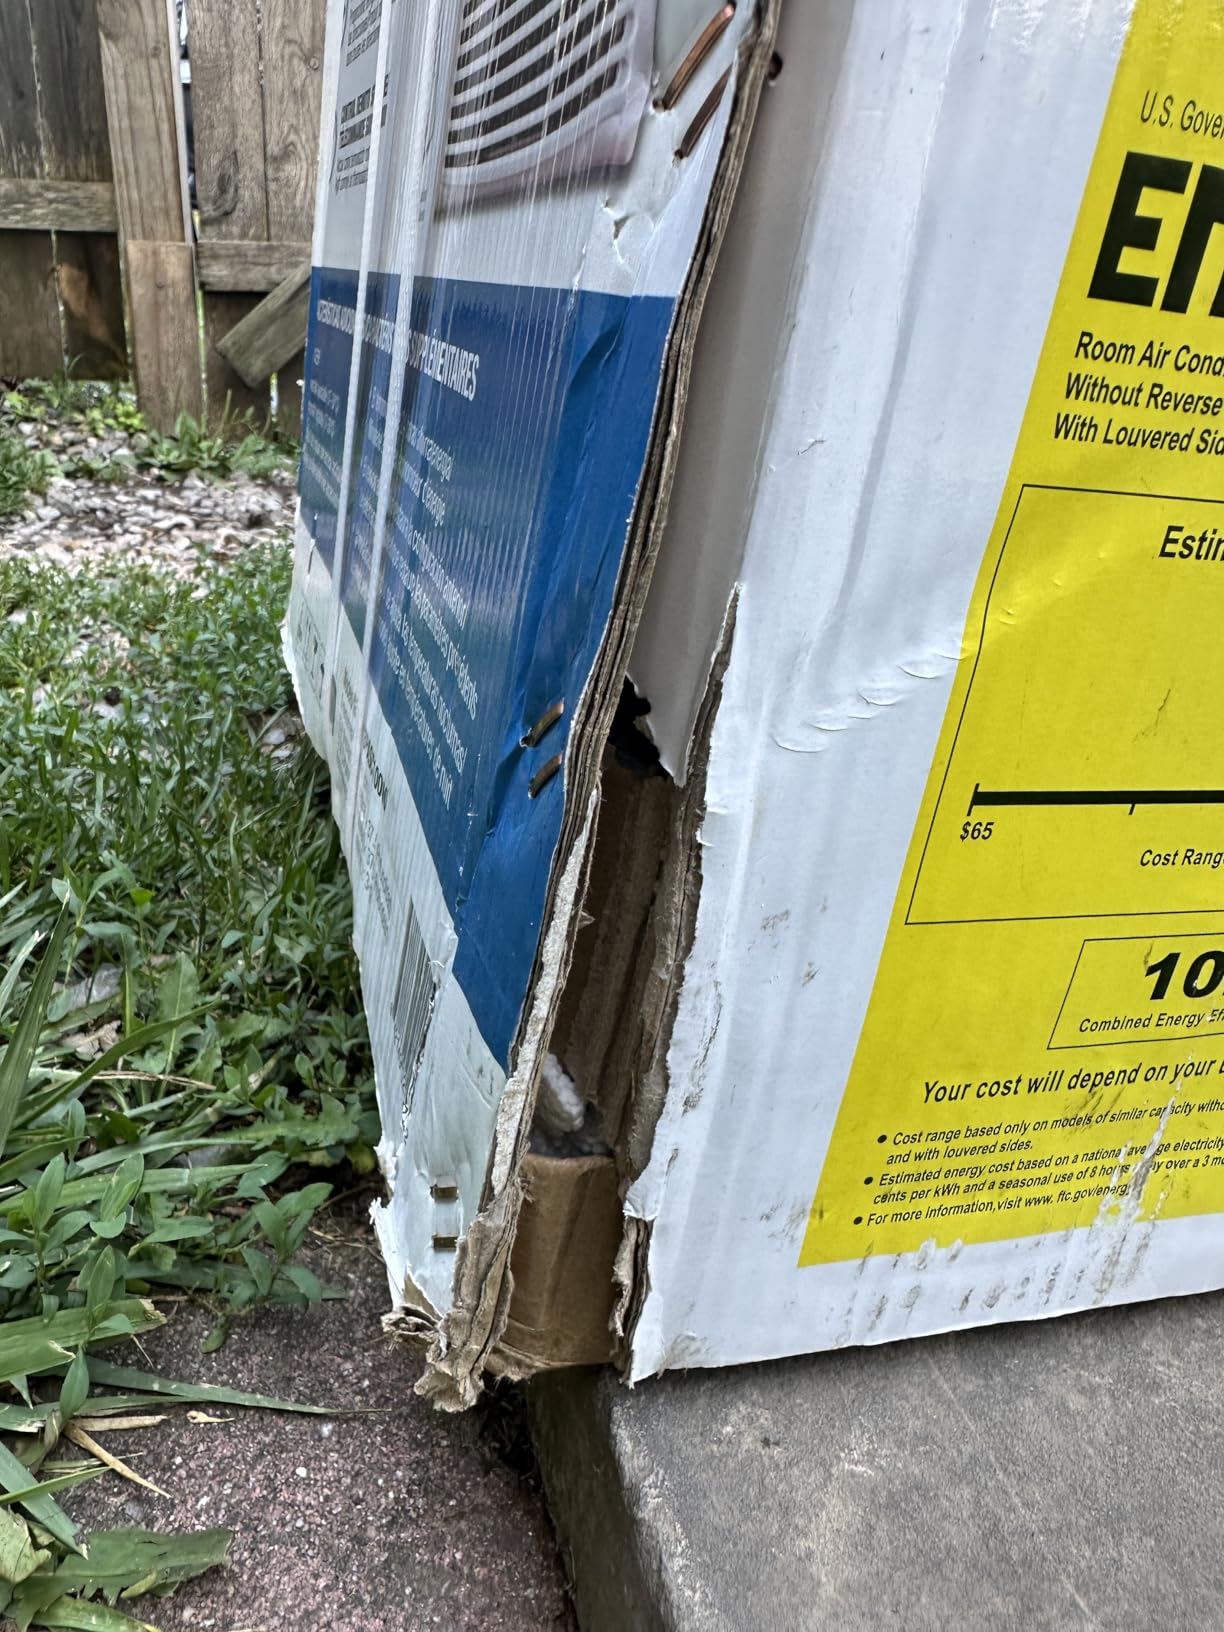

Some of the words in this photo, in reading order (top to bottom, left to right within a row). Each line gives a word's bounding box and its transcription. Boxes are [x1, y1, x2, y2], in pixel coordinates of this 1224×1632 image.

[1140, 89, 1174, 129] U.S.
[1180, 99, 1224, 140] Gove
[1074, 330, 1136, 366] Room
[1138, 340, 1172, 369] Air
[1065, 372, 1144, 408] Without
[1145, 382, 1224, 417] Reverse
[1054, 412, 1098, 443] With
[1102, 418, 1196, 453] Louvered
[960, 820, 995, 842] $65
[1140, 849, 1179, 867] Cost
[1180, 848, 1224, 869] Rang
[1079, 1013, 1153, 1033] Combined
[1155, 1012, 1206, 1028] Energy
[922, 1080, 972, 1104] Your
[975, 1073, 1024, 1099] cost
[1026, 1069, 1065, 1095] will
[1066, 1062, 1143, 1094] depend
[1143, 1064, 1168, 1082] on
[1169, 1059, 1217, 1085] your
[893, 1130, 924, 1146] Cost
[925, 1128, 961, 1144] range
[963, 1121, 1003, 1139] based
[1003, 1119, 1034, 1136] only
[1032, 1119, 1048, 1132] on
[1050, 1113, 1092, 1131] models
[1095, 1109, 1110, 1125] of
[1109, 1107, 1148, 1124] similar
[879, 1166, 942, 1187] Estimated
[943, 1163, 987, 1179] energy
[987, 1159, 1015, 1174] cost
[1016, 1154, 1052, 1171] based
[1055, 1154, 1070, 1167] on
[1080, 1145, 1125, 1162] nationa
[1127, 1141, 1171, 1157] avege
[886, 1152, 911, 1166] and
[914, 1146, 940, 1162] with
[943, 1140, 998, 1158] louvered
[998, 1138, 1033, 1153] sides.
[873, 1188, 908, 1205] cents
[909, 1187, 932, 1204] per
[933, 1183, 960, 1198] kWh
[963, 1178, 987, 1194] and
[988, 1179, 996, 1190] a
[998, 1172, 1051, 1190] seasonal
[1053, 1171, 1073, 1184] use
[1076, 1166, 1091, 1180] of
[1165, 1157, 1194, 1170] over
[1201, 1155, 1209, 1168] 3
[867, 1212, 888, 1227] For
[890, 1207, 922, 1223] more
[1024, 1194, 1053, 1208] www.
[1057, 1182, 1131, 1204] ftc.gov/energ
